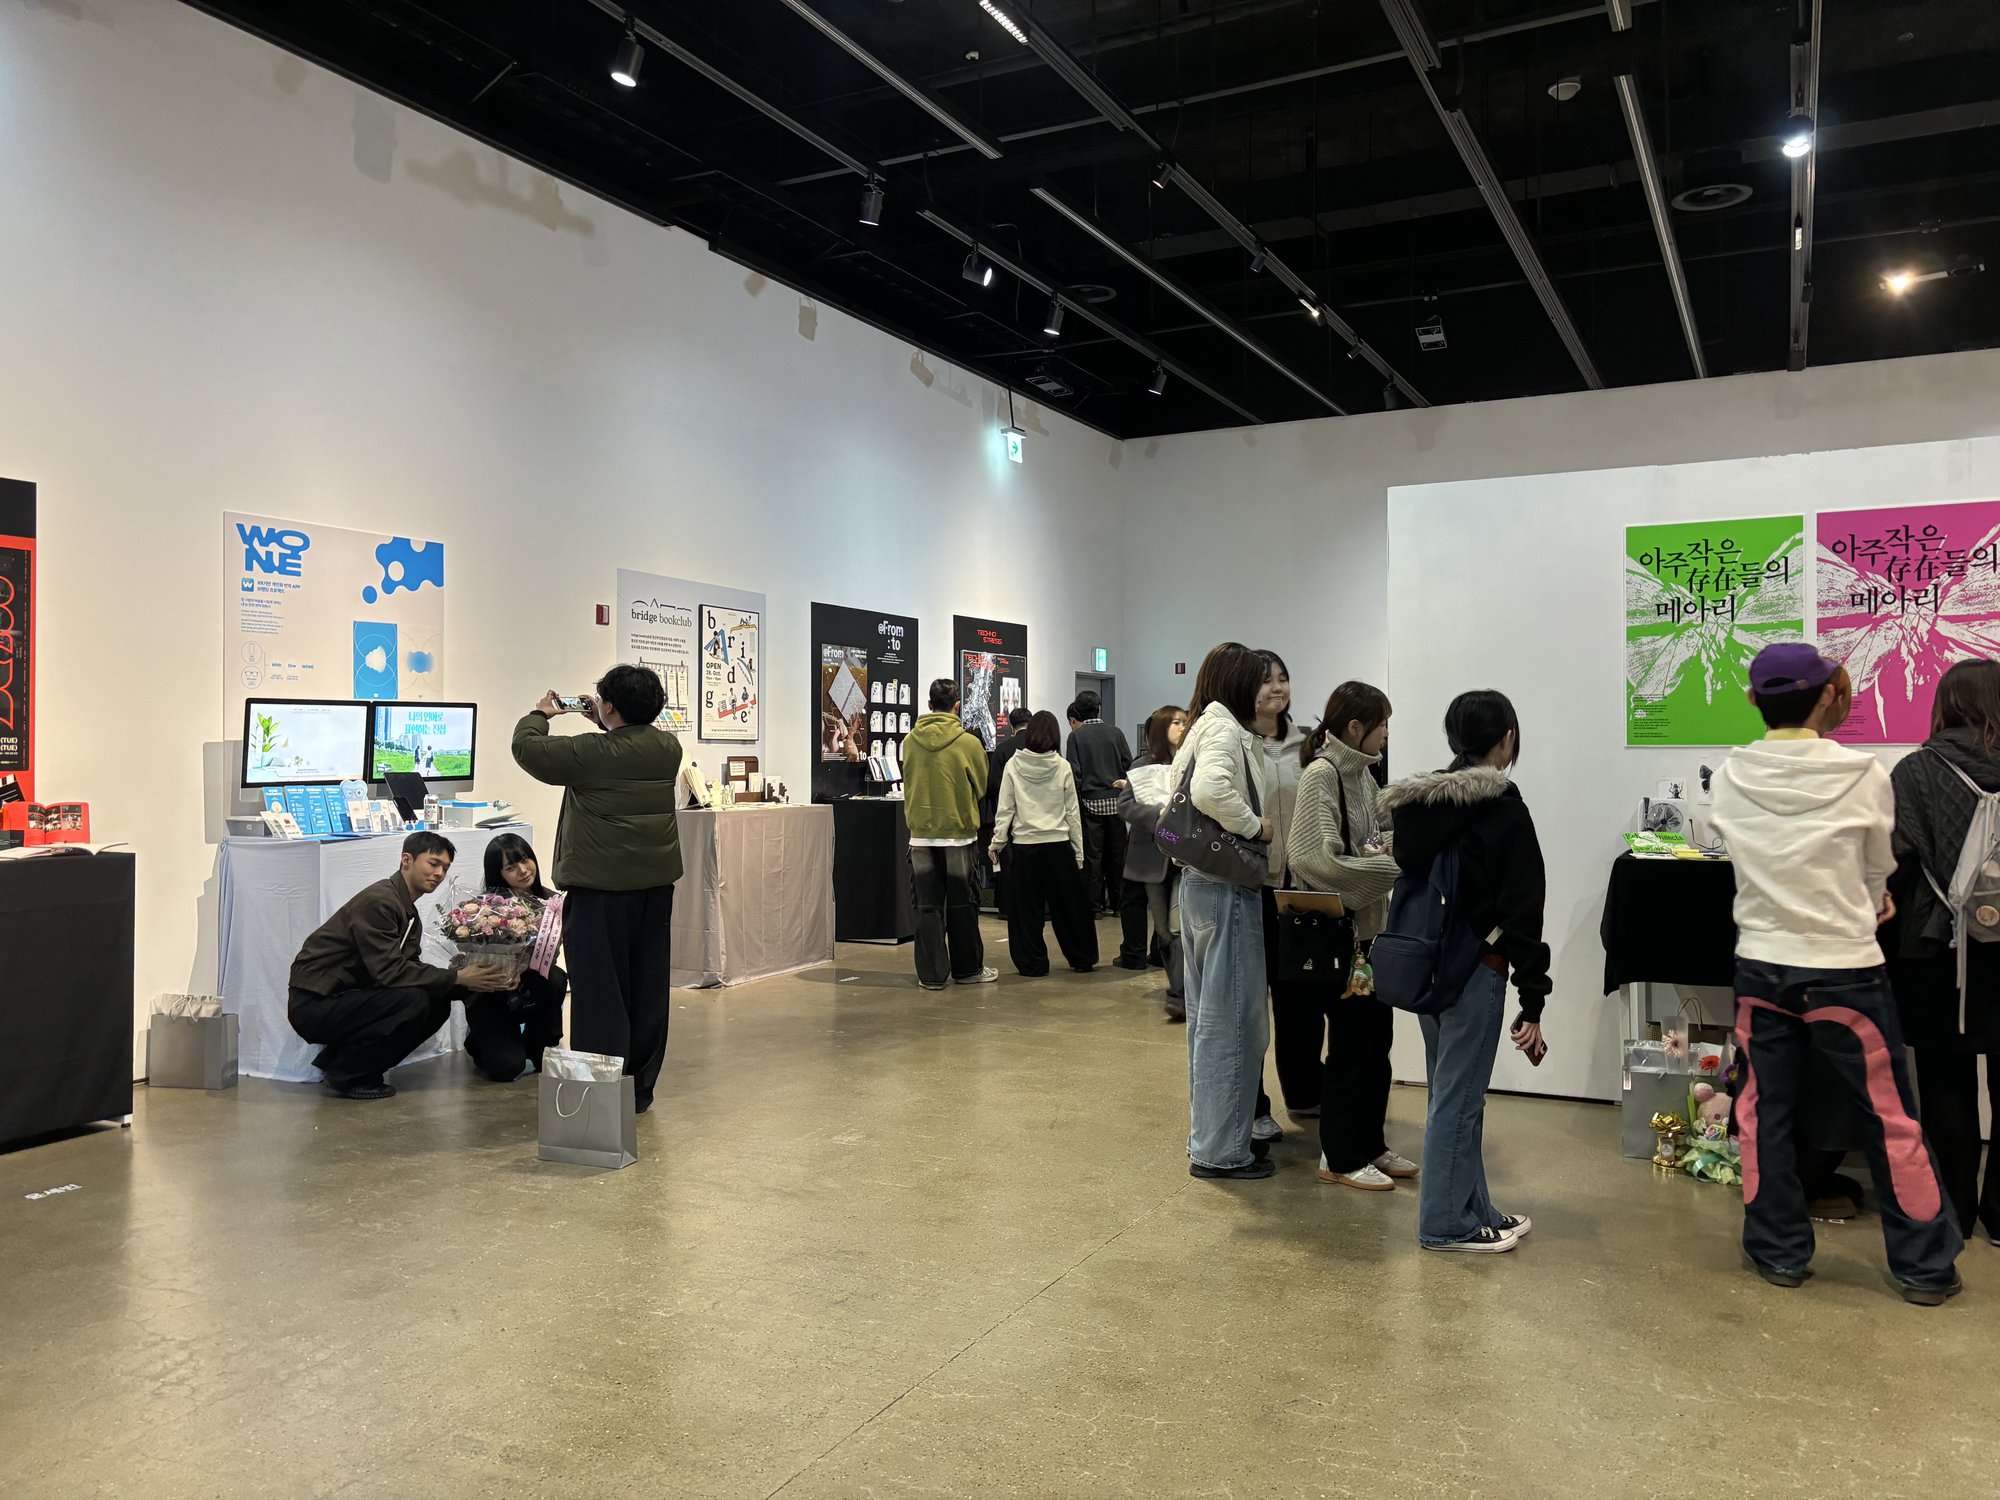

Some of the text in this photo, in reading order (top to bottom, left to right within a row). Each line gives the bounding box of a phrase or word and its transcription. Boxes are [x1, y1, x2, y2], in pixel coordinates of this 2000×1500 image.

[1656, 594, 1735, 625] 메아리
[1851, 583, 1939, 615] 메아리
[631, 608, 692, 627] bridge bookclub
